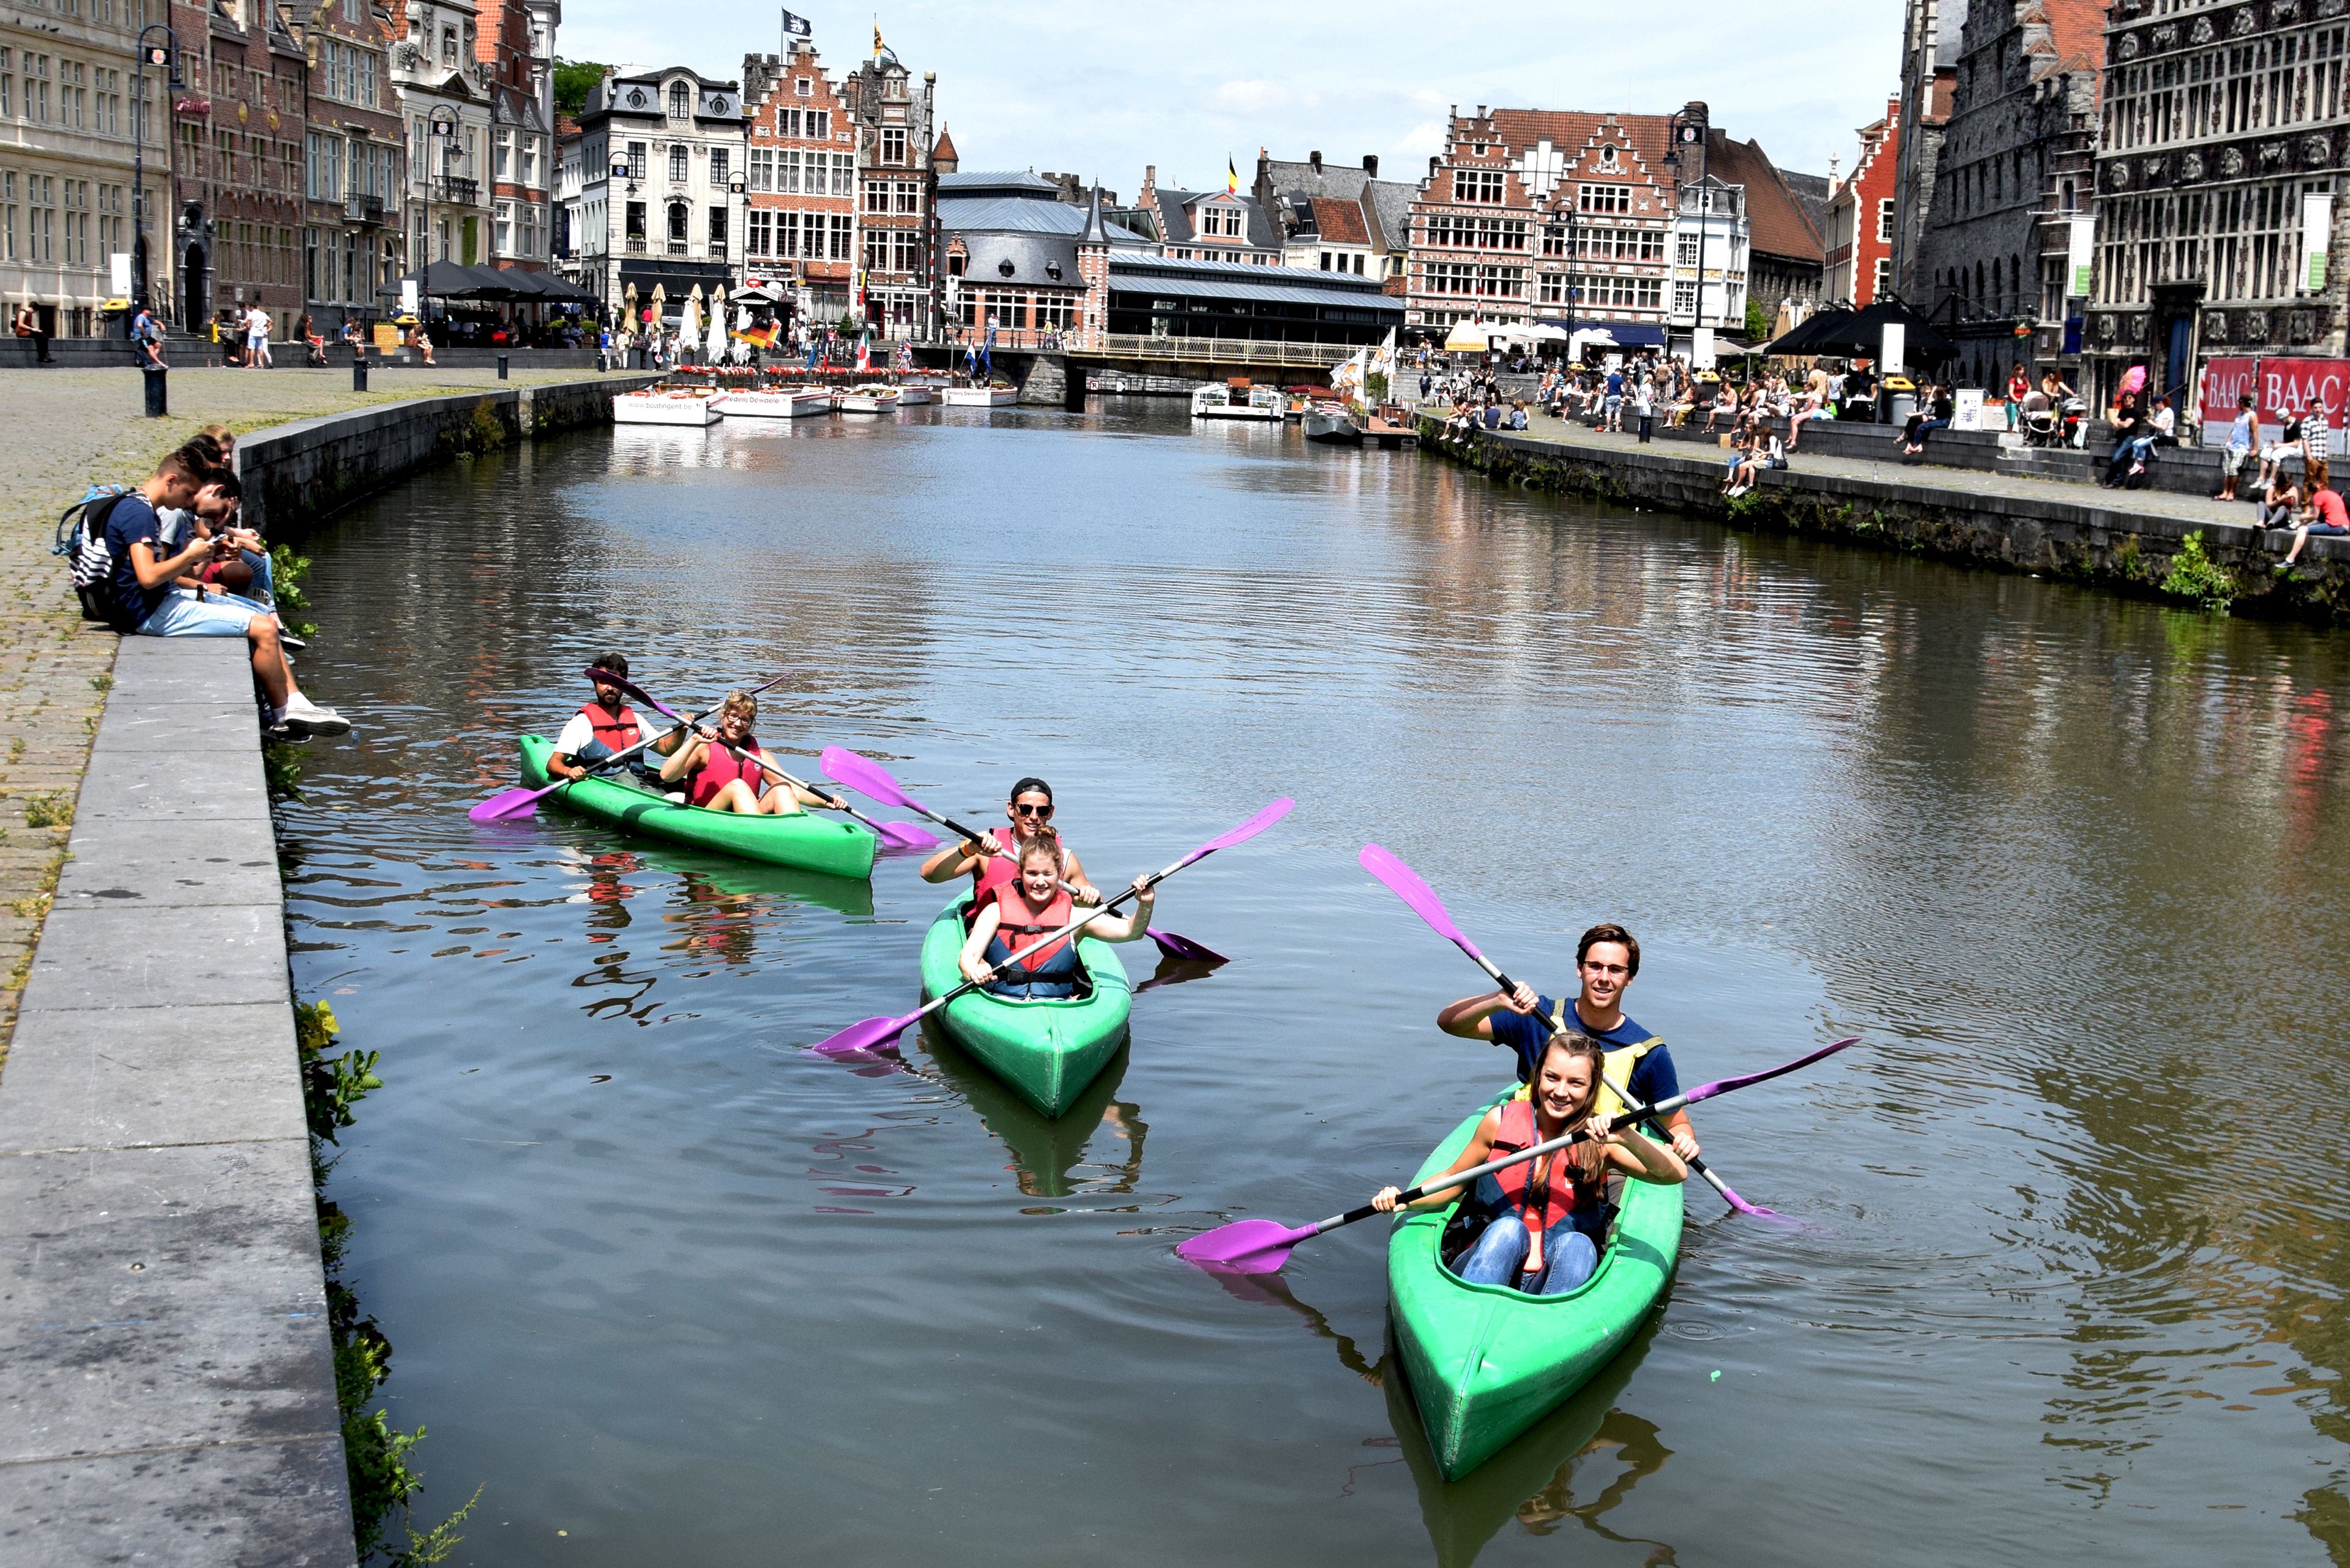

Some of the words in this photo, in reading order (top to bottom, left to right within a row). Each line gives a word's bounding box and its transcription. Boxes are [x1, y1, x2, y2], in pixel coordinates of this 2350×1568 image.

[629, 402, 692, 411] www.boatingent.be
[2208, 373, 2248, 408] BAAC
[2265, 373, 2340, 414] BAAC
